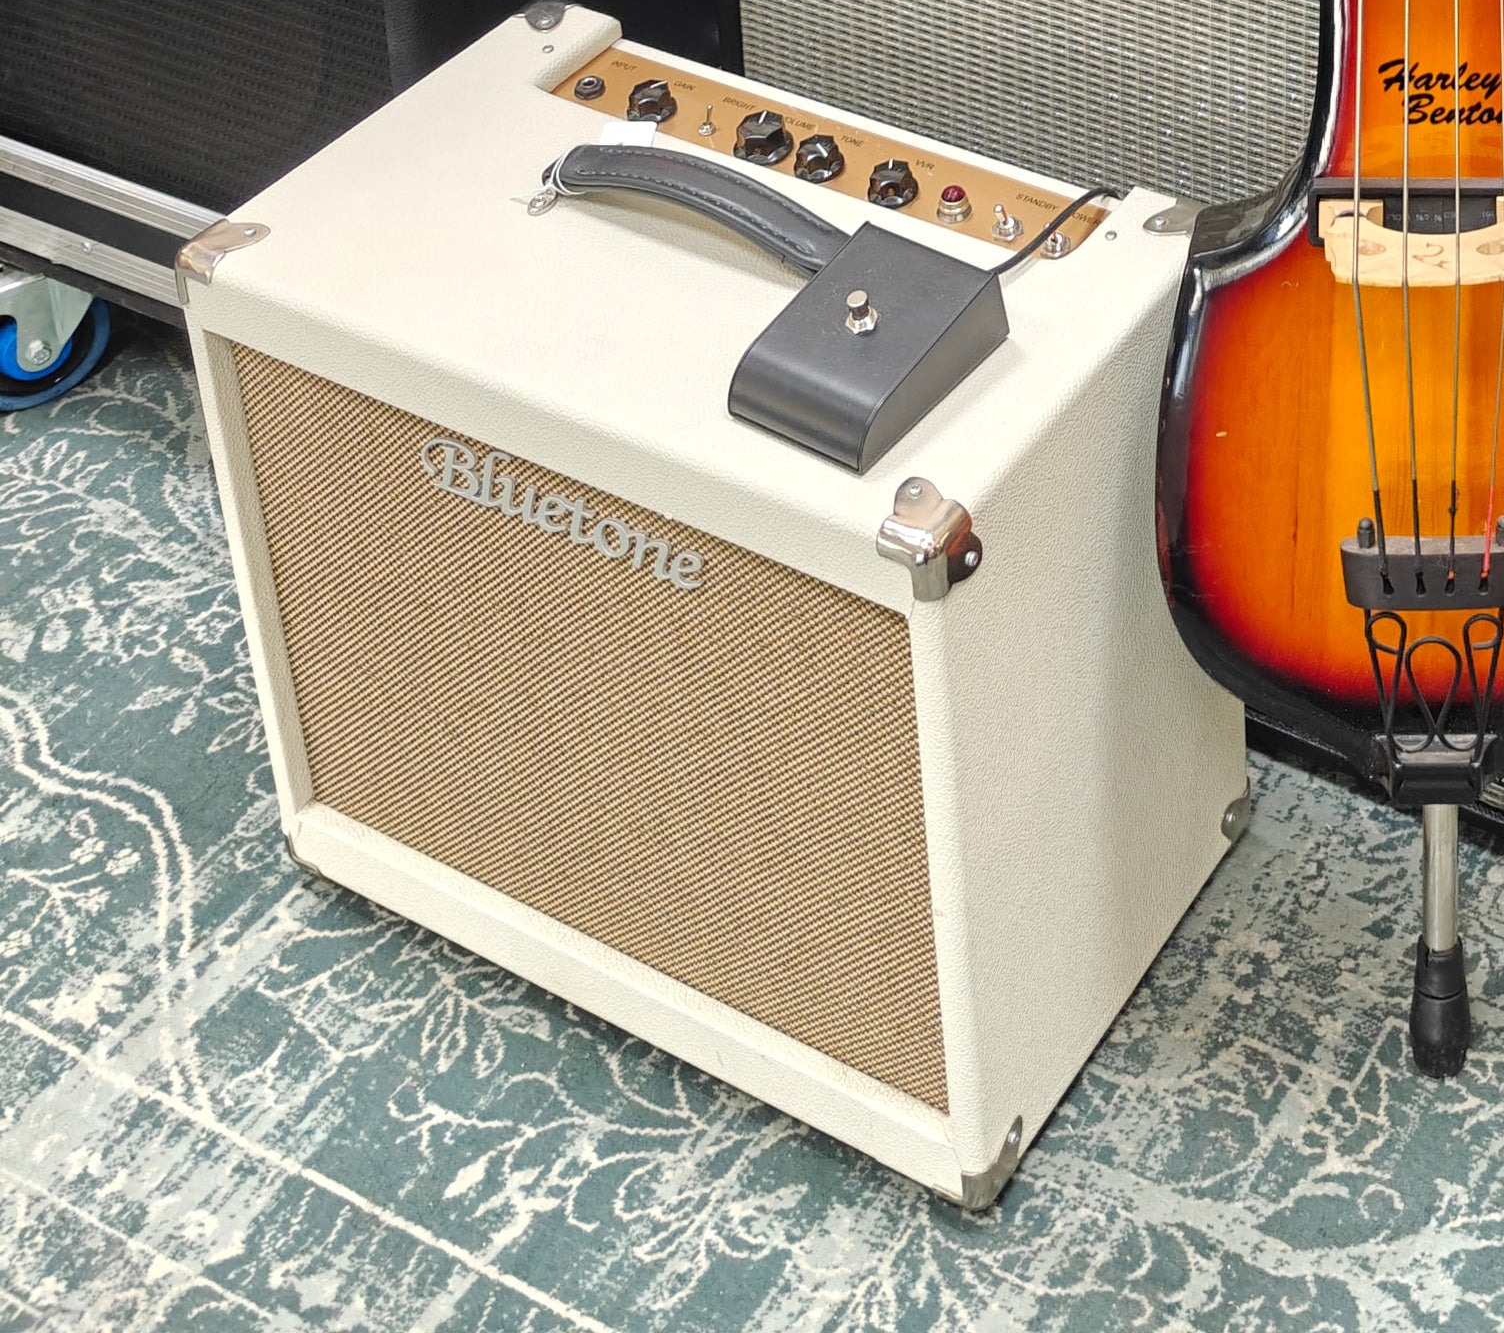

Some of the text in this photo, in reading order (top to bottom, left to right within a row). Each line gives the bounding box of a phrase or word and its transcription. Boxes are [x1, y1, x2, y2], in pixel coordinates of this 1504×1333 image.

[612, 59, 638, 73] INPUT
[674, 80, 696, 91] GAIN
[1378, 58, 1503, 100] Harley
[722, 96, 758, 111] BRIGHT
[782, 116, 816, 131] OLUME
[840, 135, 865, 147] TONE
[1016, 193, 1060, 211] STANDBY
[1072, 212, 1102, 225] OWER
[422, 438, 704, 590] Bluetone
